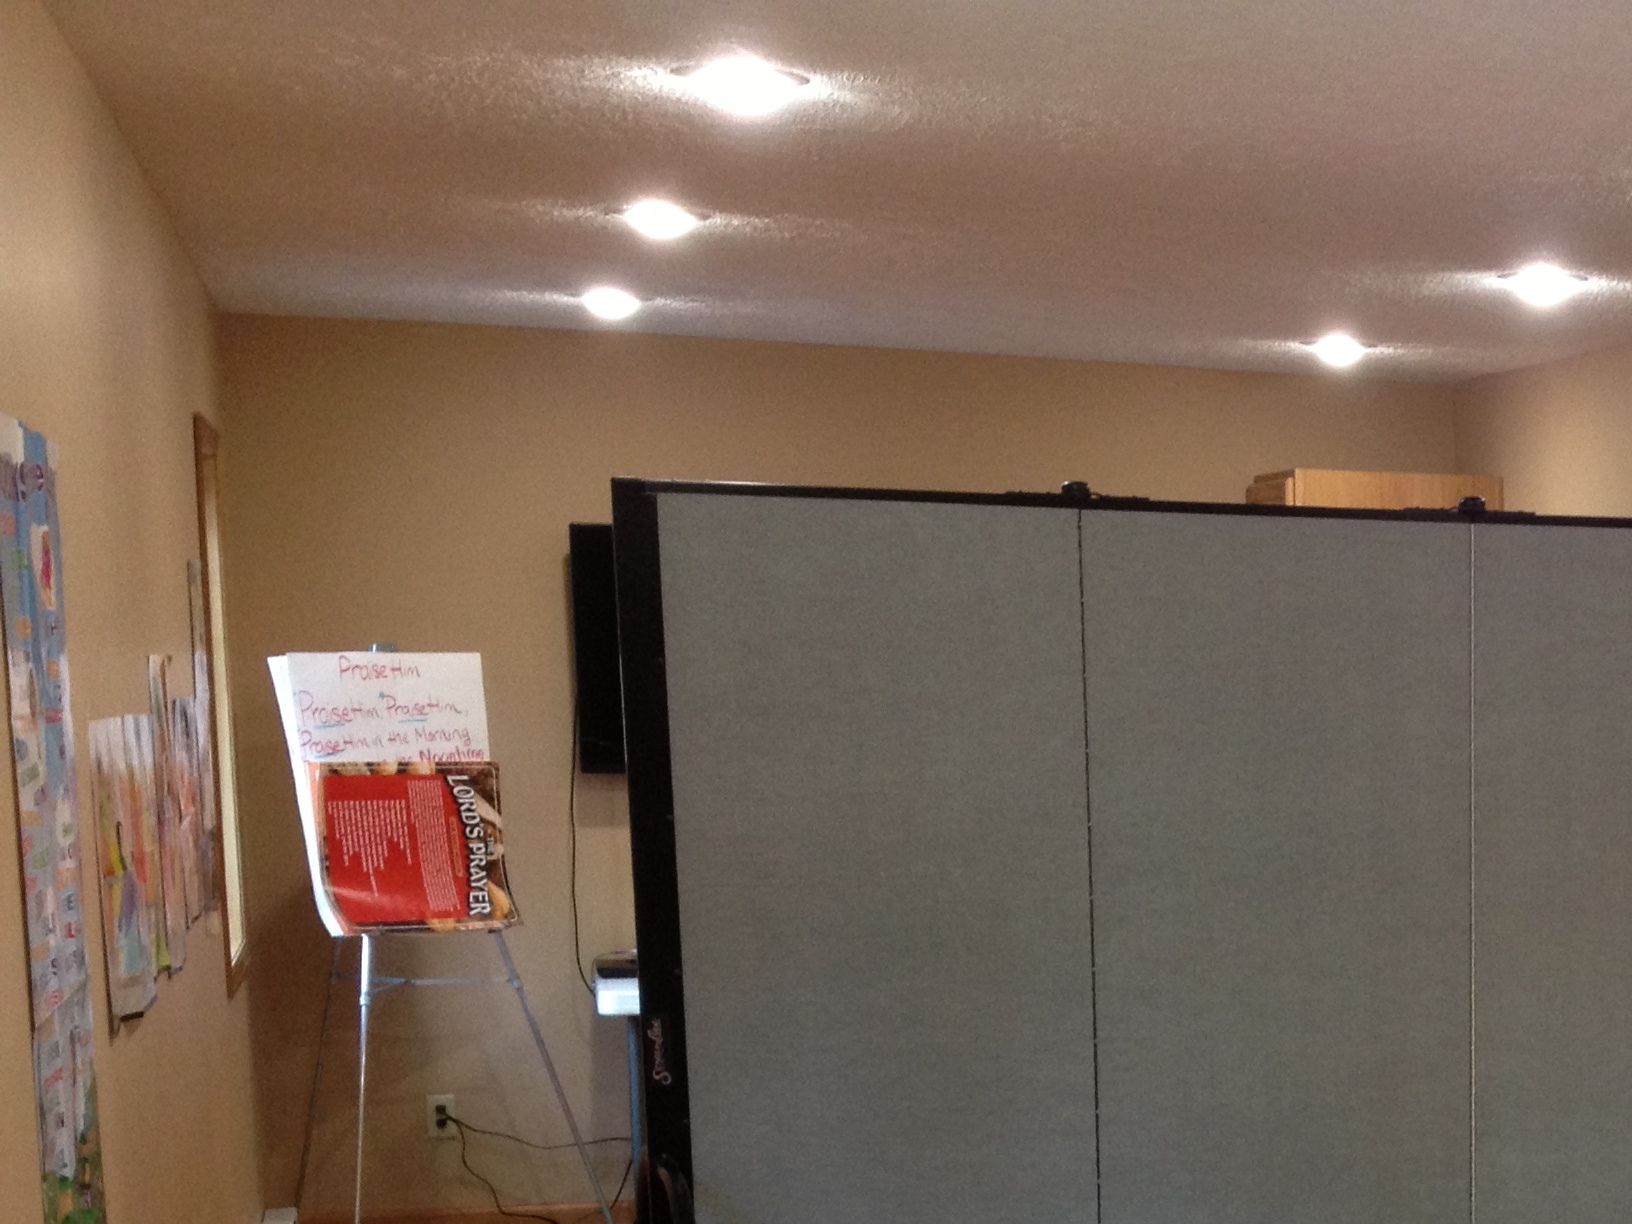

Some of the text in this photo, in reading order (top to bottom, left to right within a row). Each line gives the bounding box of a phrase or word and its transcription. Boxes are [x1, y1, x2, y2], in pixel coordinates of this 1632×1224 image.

[338, 655, 420, 680] Praise Him
[298, 690, 352, 726] Praise
[382, 694, 429, 717] Praise
[387, 729, 409, 745] the
[414, 726, 471, 746] Morning
[446, 774, 485, 839] LORD'S
[468, 842, 492, 916] PRAYER
